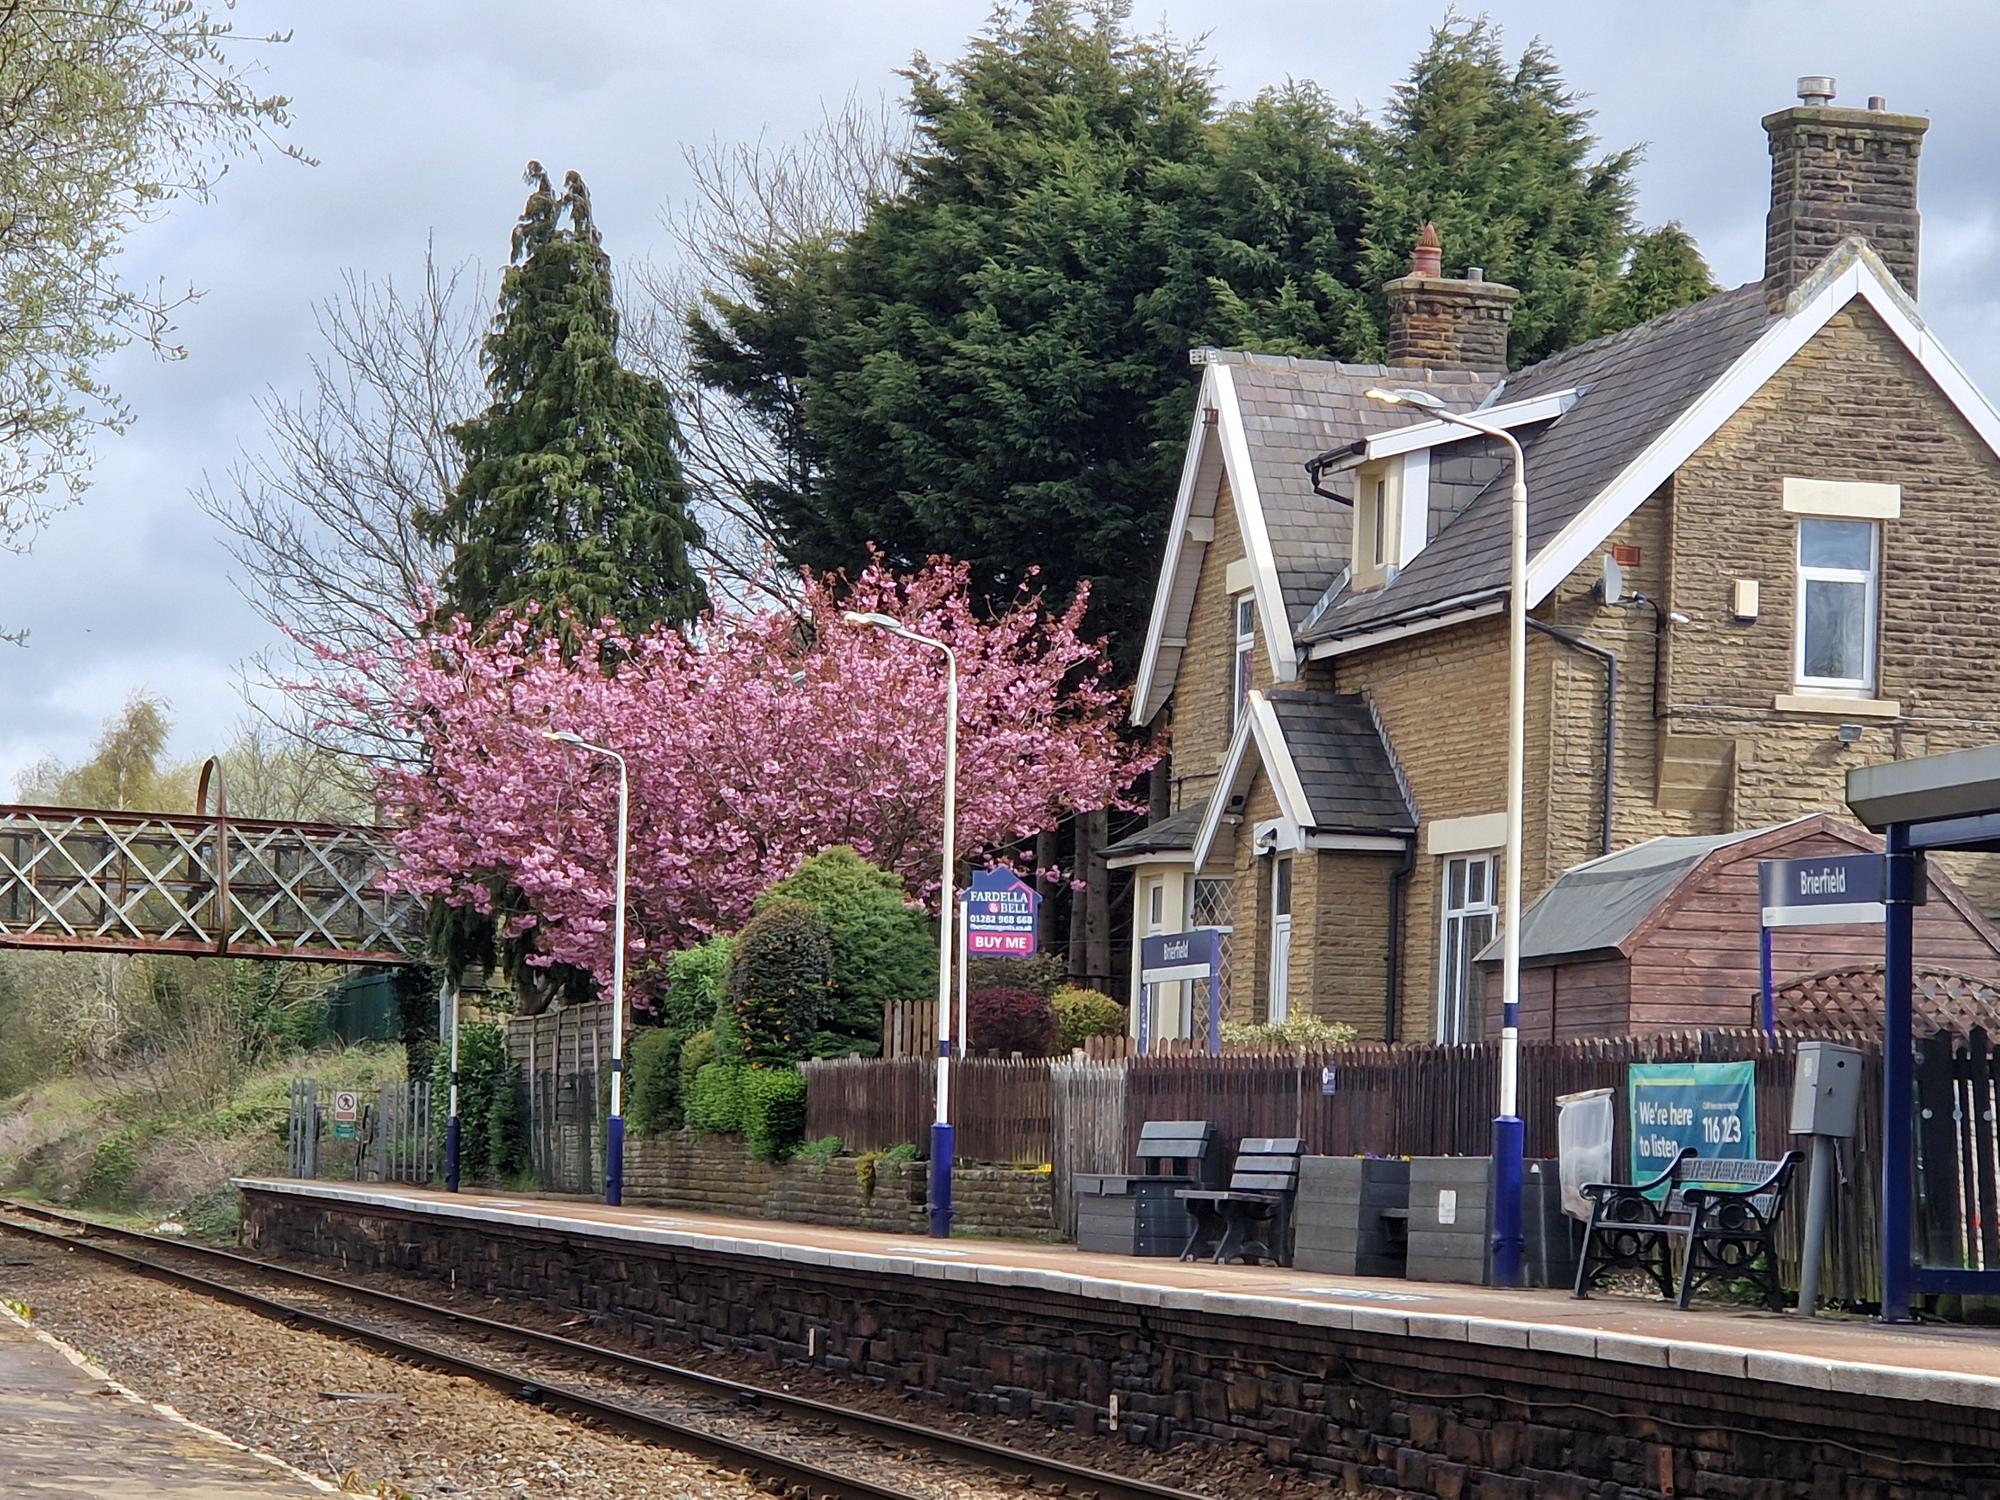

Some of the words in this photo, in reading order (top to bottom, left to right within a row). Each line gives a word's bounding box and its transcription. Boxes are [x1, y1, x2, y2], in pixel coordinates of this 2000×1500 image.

[1800, 867, 1845, 895] Brierfield
[970, 891, 1028, 903] FARDELLA
[988, 902, 999, 913] &
[1000, 903, 1028, 914] BELL
[970, 914, 996, 923] 01282
[975, 936, 1002, 948] BUY
[1005, 937, 1027, 949] ME
[1163, 940, 1189, 960] Brierfield
[1639, 1101, 1668, 1126] We're
[1670, 1102, 1693, 1126] here
[1702, 1116, 1720, 1144] 116
[1722, 1115, 1742, 1143] 123
[1640, 1136, 1650, 1157] to
[1651, 1134, 1678, 1158] listen
